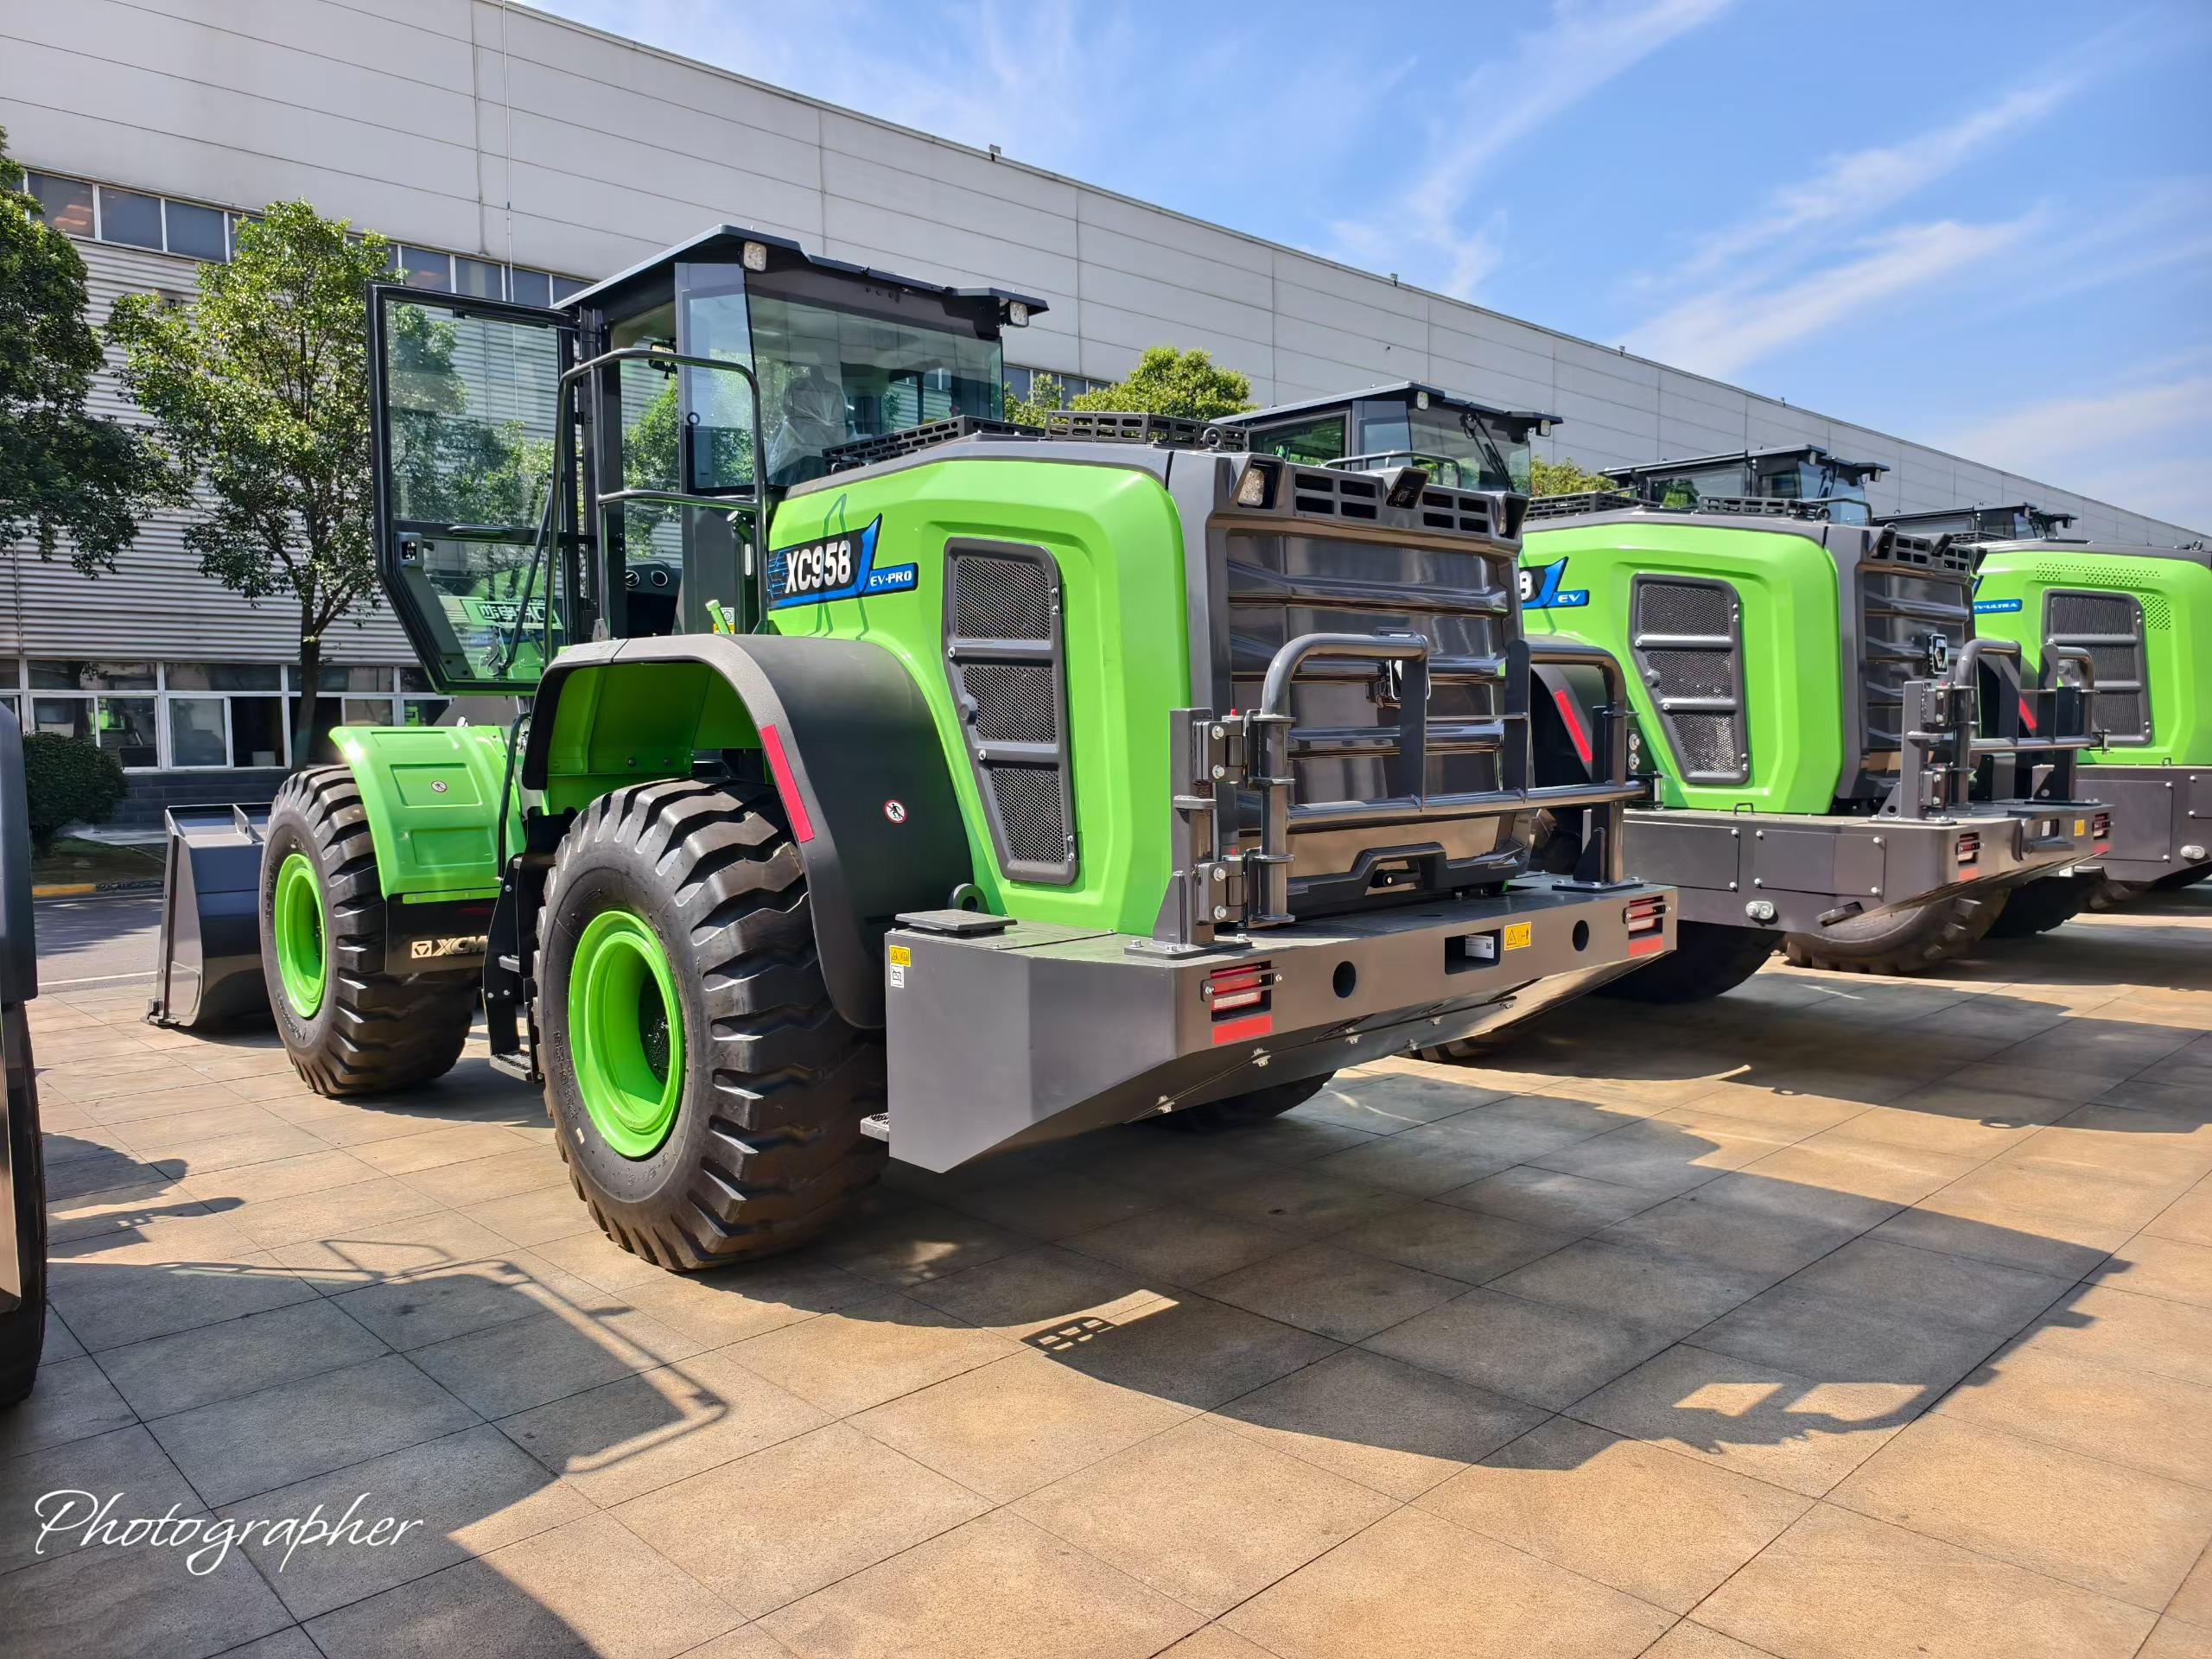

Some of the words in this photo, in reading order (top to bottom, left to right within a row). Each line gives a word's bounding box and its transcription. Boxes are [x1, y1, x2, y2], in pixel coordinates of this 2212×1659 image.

[785, 540, 851, 594] XC958
[1557, 594, 1580, 603] EV
[433, 935, 488, 957] XCM
